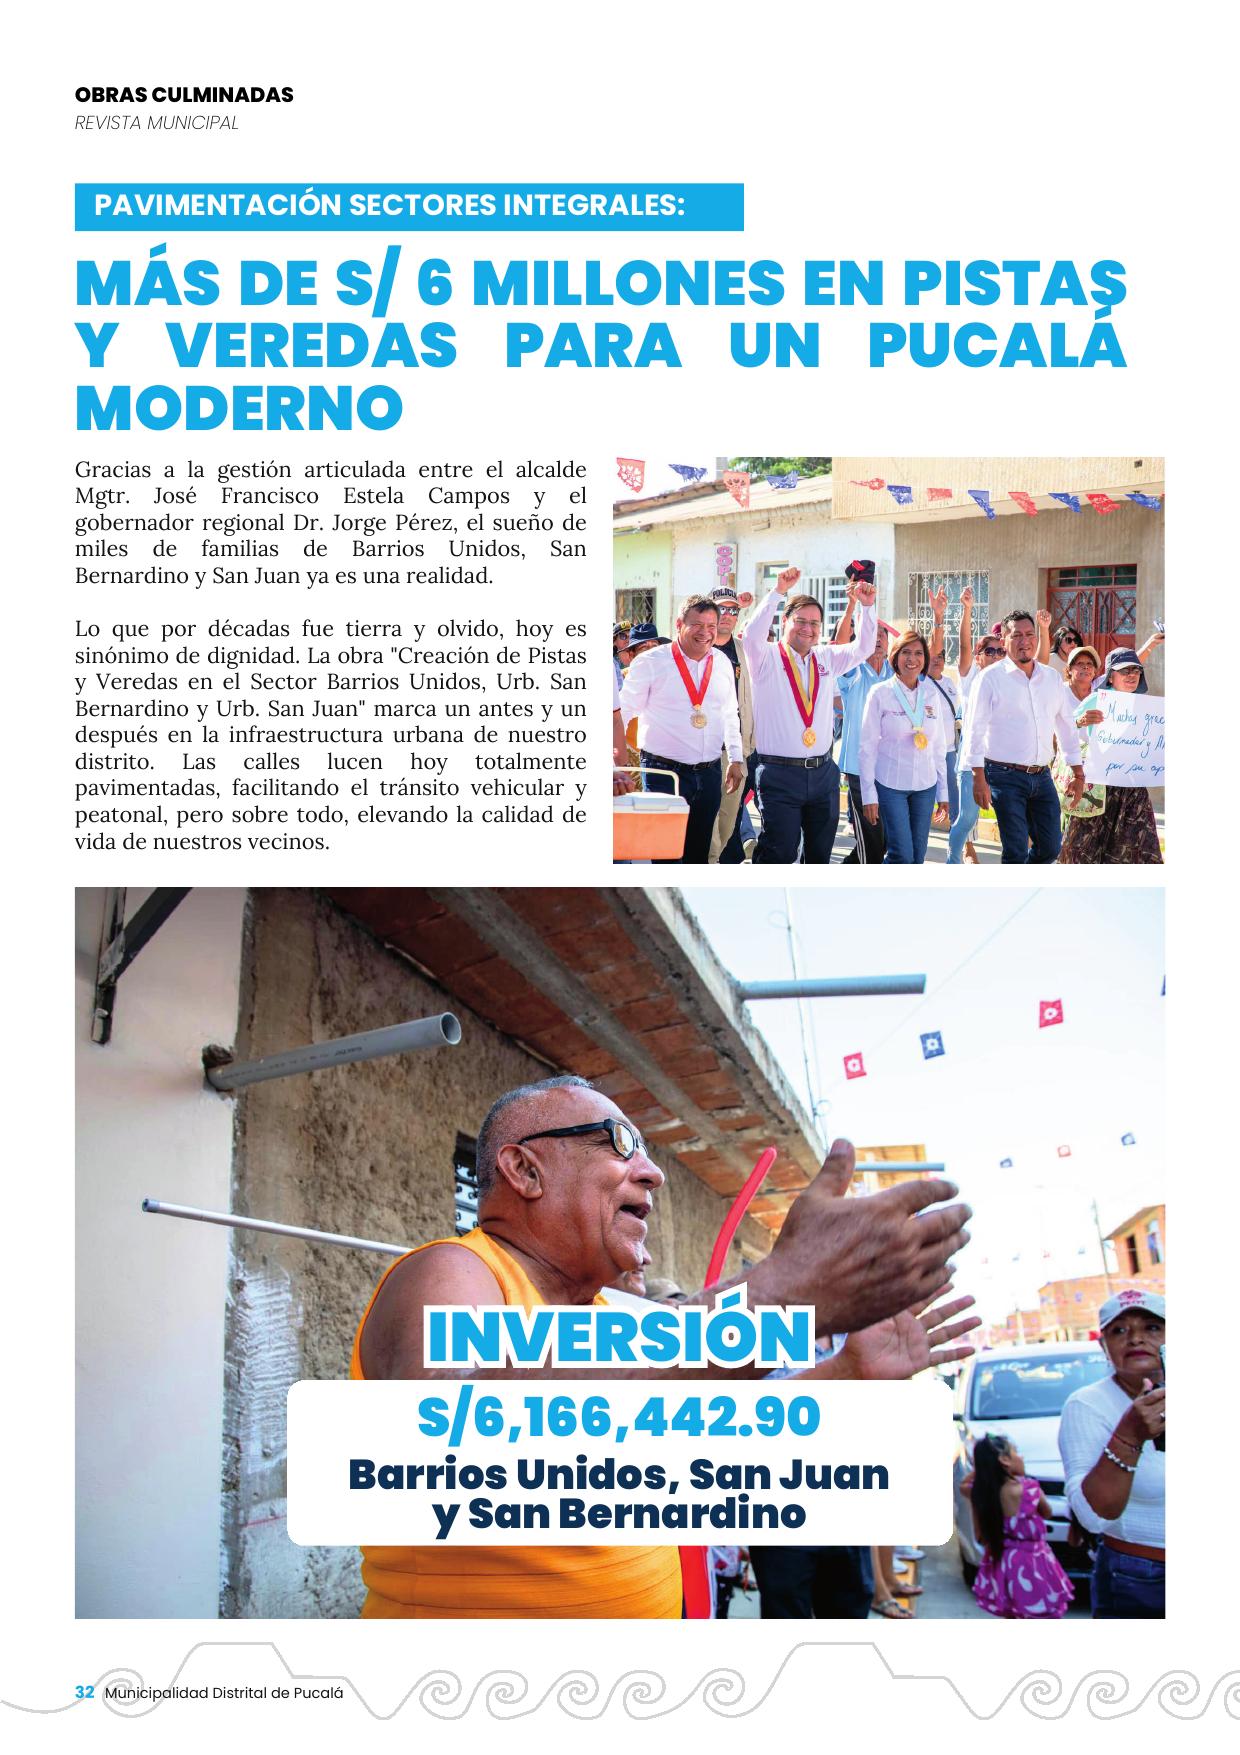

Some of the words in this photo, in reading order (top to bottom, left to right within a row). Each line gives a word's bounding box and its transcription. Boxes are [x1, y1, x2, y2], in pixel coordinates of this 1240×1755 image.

[74, 86, 148, 103] OBRAS
[151, 86, 294, 103] CULMINADAS
[74, 114, 141, 130] REVISTA
[147, 114, 239, 130] MUNICIPAL
[95, 187, 341, 216] PAVIMENTACIÓN
[349, 193, 496, 216] SECTORES
[504, 193, 685, 216] INTEGRALES:
[76, 241, 220, 307] MÁS
[240, 260, 318, 306] DE
[417, 257, 453, 307] 6
[473, 259, 785, 307] MILLONES
[804, 260, 884, 306] EN
[904, 259, 1127, 307] PISTAS
[74, 322, 120, 368] Y
[164, 321, 457, 369] VEREDAS
[506, 322, 683, 368] PARA
[730, 322, 820, 368] UN
[869, 304, 1128, 369] PUCALÁ
[76, 384, 403, 431] MODERNO
[75, 460, 152, 478] Gracias
[163, 465, 176, 478] a
[187, 460, 205, 478] la
[217, 459, 292, 484] gestión
[304, 459, 406, 478] articulada
[418, 462, 473, 478] entre
[486, 460, 504, 478] el
[515, 459, 587, 478] alcalde
[75, 487, 130, 510] Mgtr.
[153, 485, 197, 504] José
[221, 486, 319, 504] Francisco
[343, 485, 405, 504] Estela
[428, 486, 510, 510] Campos
[533, 491, 546, 510] y
[569, 485, 587, 504] el
[75, 512, 195, 537] gobernador
[202, 513, 285, 537] regional
[293, 514, 324, 531] Dr.
[331, 514, 387, 537] Jorge
[395, 512, 458, 535] Pérez,
[466, 513, 485, 531] el
[493, 513, 554, 531] sueño
[562, 512, 587, 531] de
[75, 538, 129, 557] miles
[152, 539, 177, 557] de
[201, 538, 279, 557] familias
[303, 539, 328, 557] de
[352, 539, 425, 557] Barrios
[449, 539, 526, 561] Unidos,
[550, 539, 587, 557] San
[75, 566, 189, 584] Bernardino
[194, 571, 207, 590] y
[212, 566, 249, 584] San
[254, 567, 301, 584] Juan
[306, 571, 330, 590] ya
[335, 571, 357, 584] es
[363, 571, 401, 584] una
[406, 565, 493, 584] realidad.
[75, 620, 100, 637] Lo
[112, 624, 149, 643] que
[161, 624, 197, 643] por
[208, 618, 290, 637] décadas
[301, 618, 334, 637] fue
[345, 619, 403, 637] tierra
[413, 624, 426, 643] y
[437, 618, 504, 641] olvido,
[515, 619, 554, 643] hoy
[565, 624, 587, 637] es
[75, 645, 169, 664] sinónimo
[175, 646, 200, 664] de
[207, 645, 300, 670] dignidad.
[307, 647, 331, 664] La
[337, 646, 384, 664] obra
[391, 645, 490, 664] "Creación
[496, 646, 521, 664] de
[528, 646, 587, 665] Pistas
[74, 677, 87, 696] y
[95, 672, 178, 690] Veredas
[188, 677, 213, 690] en
[222, 672, 241, 690] el
[250, 672, 318, 690] Sector
[327, 672, 400, 690] Barrios
[409, 671, 486, 694] Unidos,
[496, 672, 540, 690] Urb.
[550, 672, 587, 690] San
[75, 699, 189, 717] Bernardino
[196, 704, 209, 723] y
[216, 699, 260, 717] Urb.
[268, 699, 305, 717] San
[311, 699, 365, 717] Juan"
[374, 704, 437, 717] marca
[444, 704, 471, 717] un
[478, 701, 534, 717] antes
[540, 704, 554, 723] y
[560, 704, 587, 717] un
[75, 724, 158, 749] después
[167, 730, 193, 743] en
[202, 725, 220, 743] la
[229, 724, 384, 743] infraestructura
[393, 724, 465, 743] urbana
[473, 725, 498, 743] de
[508, 727, 587, 743] nuestro
[75, 752, 154, 770] distrito.
[182, 753, 216, 771] Las
[243, 751, 300, 770] calles
[327, 751, 383, 770] lucen
[410, 751, 449, 776] hoy
[474, 752, 587, 770] totalmente
[75, 778, 220, 802] pavimentadas,
[231, 777, 339, 796] facilitando
[350, 777, 369, 796] el
[379, 777, 460, 796] tránsito
[470, 777, 565, 797] vehicular
[574, 783, 588, 802] y
[75, 805, 168, 829] peatonal,
[176, 810, 224, 829] pero
[232, 805, 289, 823] sobre
[296, 805, 349, 826] todo,
[357, 804, 448, 823] elevando
[456, 804, 474, 823] la
[481, 805, 554, 823] calidad
[562, 804, 587, 823] de
[74, 831, 117, 850] vida
[122, 832, 147, 850] de
[153, 834, 242, 850] nuestros
[247, 832, 330, 850] vecinos.
[75, 1685, 95, 1699] 32
[105, 1686, 209, 1703] Municipalidad
[213, 1686, 267, 1699] Distrital
[271, 1686, 290, 1699] de
[294, 1686, 344, 1699] Pucalá
